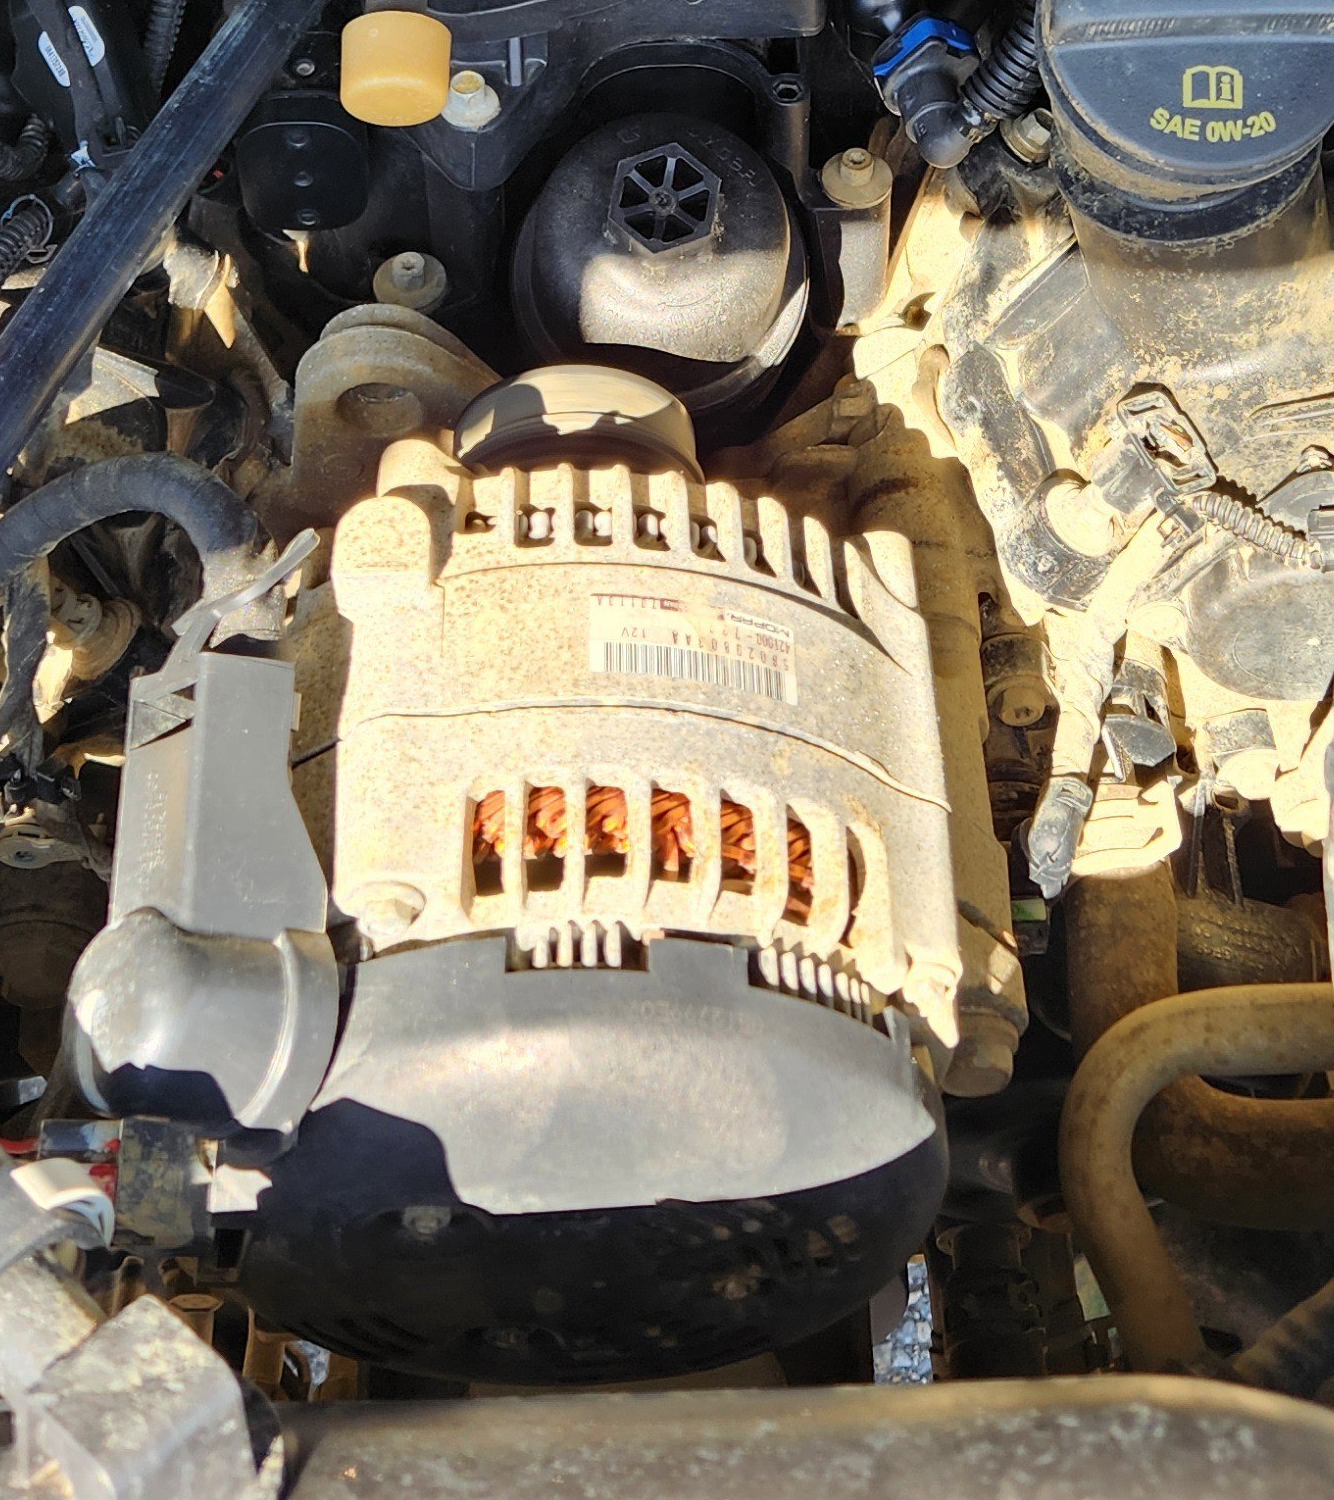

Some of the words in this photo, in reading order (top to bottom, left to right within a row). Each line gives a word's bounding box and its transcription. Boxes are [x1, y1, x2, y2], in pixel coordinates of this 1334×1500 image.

[1149, 107, 1201, 141] SAE
[1205, 111, 1277, 143] 0W-20
[621, 626, 647, 640] 12V
